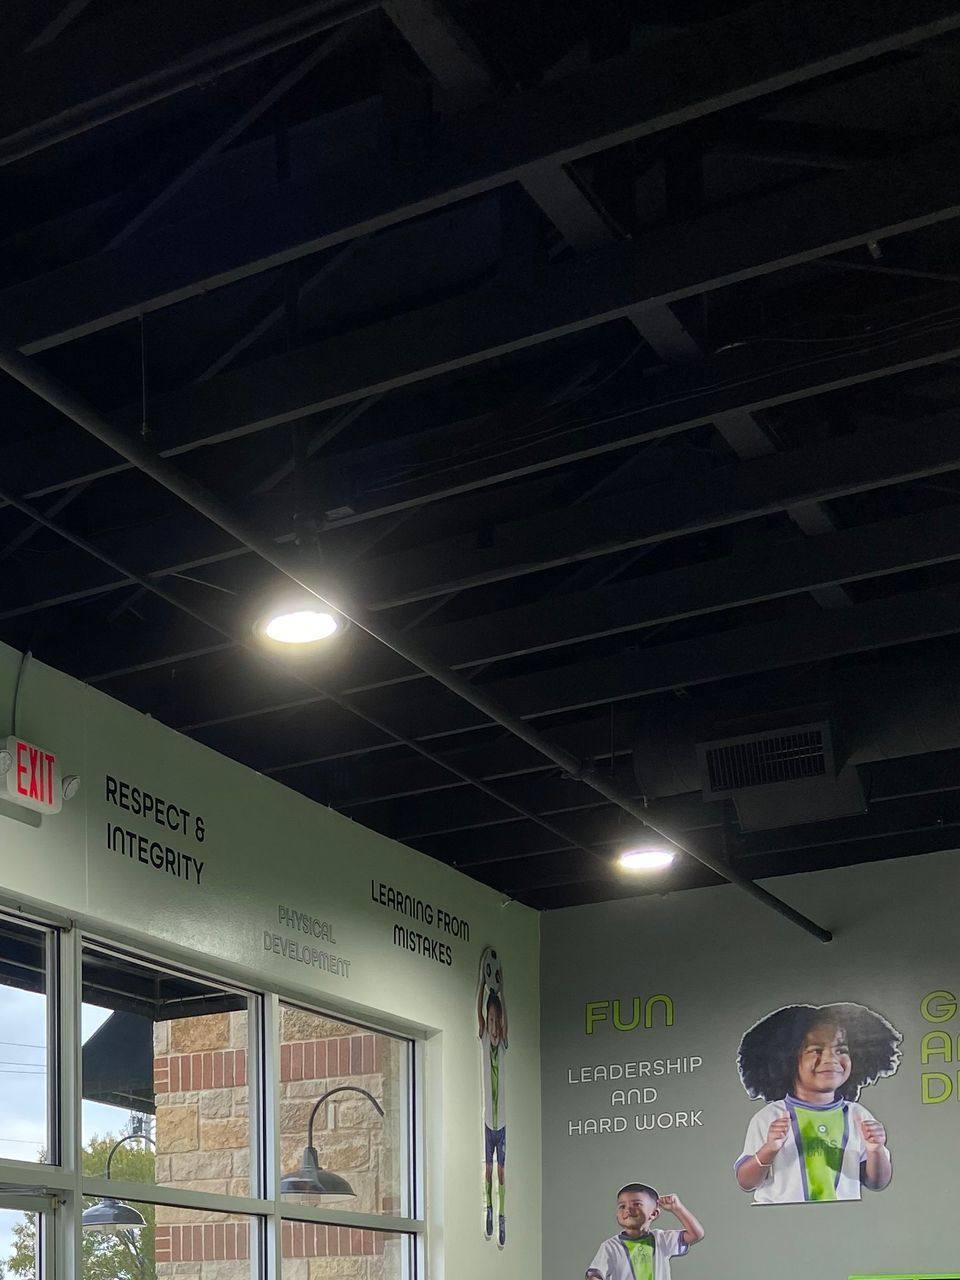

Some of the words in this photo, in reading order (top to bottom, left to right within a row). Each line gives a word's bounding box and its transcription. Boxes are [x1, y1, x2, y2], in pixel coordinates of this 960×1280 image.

[16, 741, 56, 805] EXIT
[105, 774, 190, 836] RESPECT
[195, 816, 206, 843] &
[107, 822, 204, 885] INTEGRITY
[278, 904, 337, 945] PHYSICAL
[371, 879, 434, 926] LEARNING
[437, 909, 470, 943] FROM
[263, 931, 352, 979] DEVELOPMENT
[393, 923, 453, 967] MISTAKES
[584, 993, 676, 1036] FUN
[921, 1030, 960, 1065] A
[567, 1056, 703, 1085] LEADERSHIP
[921, 1071, 960, 1105] D
[611, 1087, 658, 1107] AND
[568, 1116, 628, 1136] HARD
[634, 1110, 704, 1131] WORK
